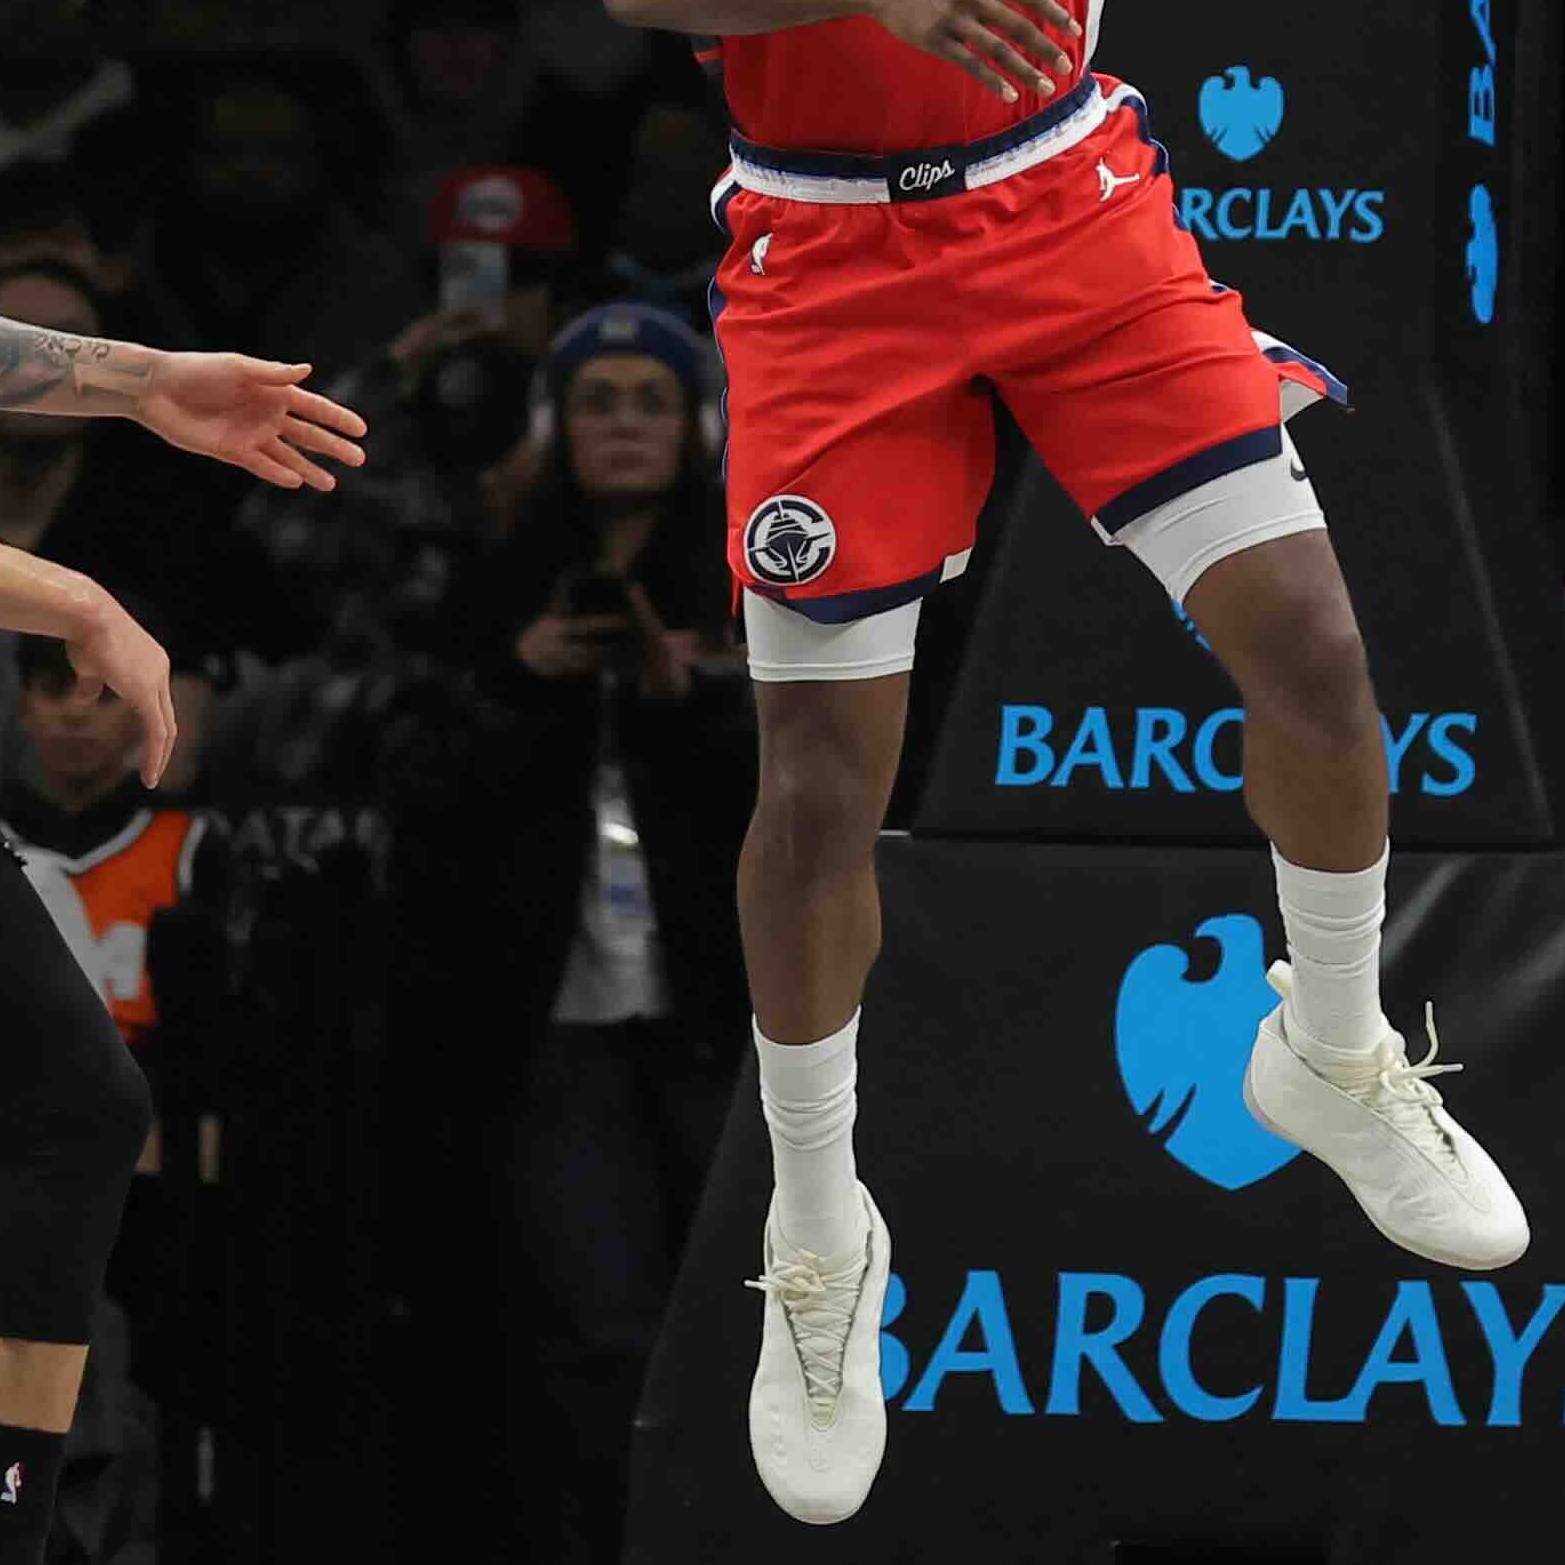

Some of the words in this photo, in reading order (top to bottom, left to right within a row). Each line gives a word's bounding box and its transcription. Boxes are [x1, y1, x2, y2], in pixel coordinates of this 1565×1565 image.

[899, 159, 956, 191] Clips
[1179, 186, 1386, 244] RCLAYS
[994, 704, 1477, 796] BARCYS
